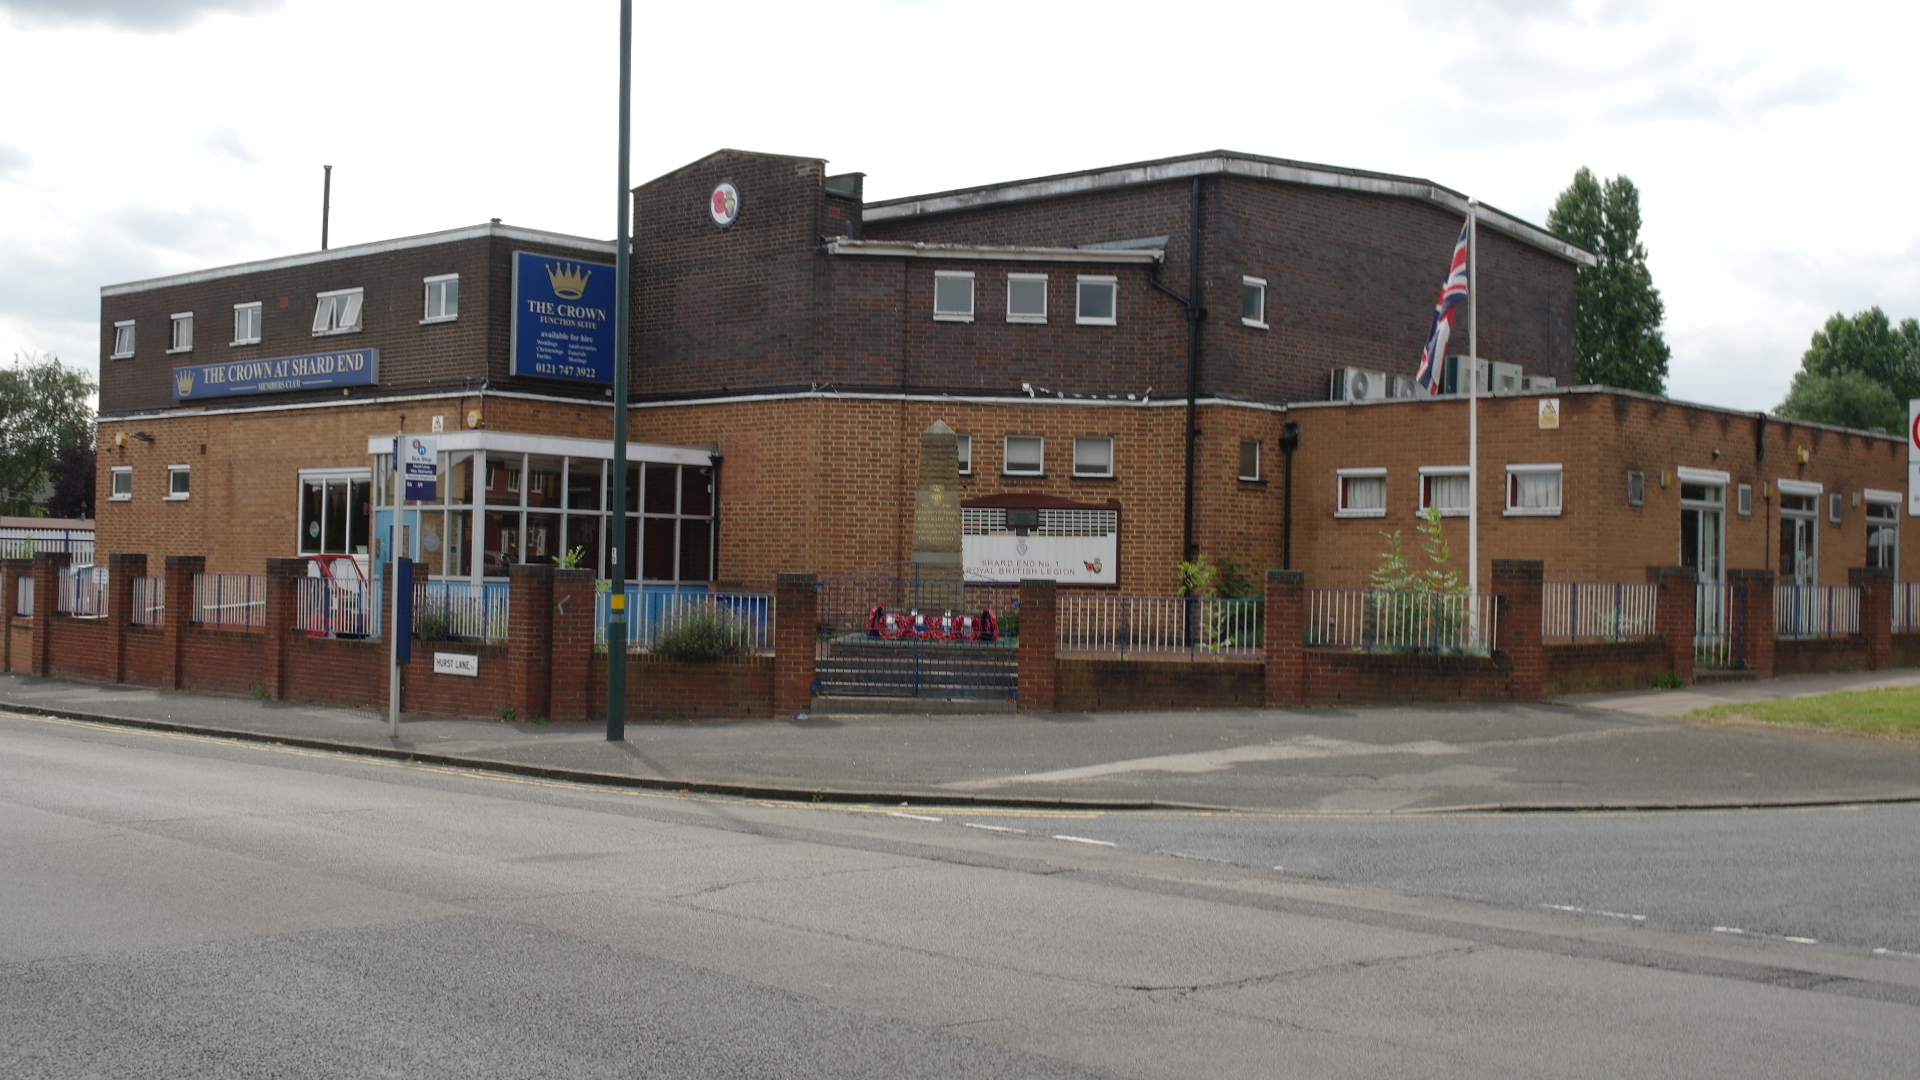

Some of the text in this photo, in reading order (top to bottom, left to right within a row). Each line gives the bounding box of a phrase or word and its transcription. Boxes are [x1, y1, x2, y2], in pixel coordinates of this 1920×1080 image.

[527, 300, 606, 321] THE CROWN
[540, 316, 597, 330] FUNCTION SUITE
[541, 331, 593, 343] available for hire
[203, 353, 364, 384] THE CROWN AT SHARD END
[536, 363, 596, 378] 0121 747 3922
[258, 379, 301, 391] MEMBERS CLUB
[981, 559, 1013, 567] SHARD
[966, 567, 1075, 576] ROYAL BRITISH LEGION
[436, 659, 454, 668] HURST
[455, 660, 470, 671] LANE
